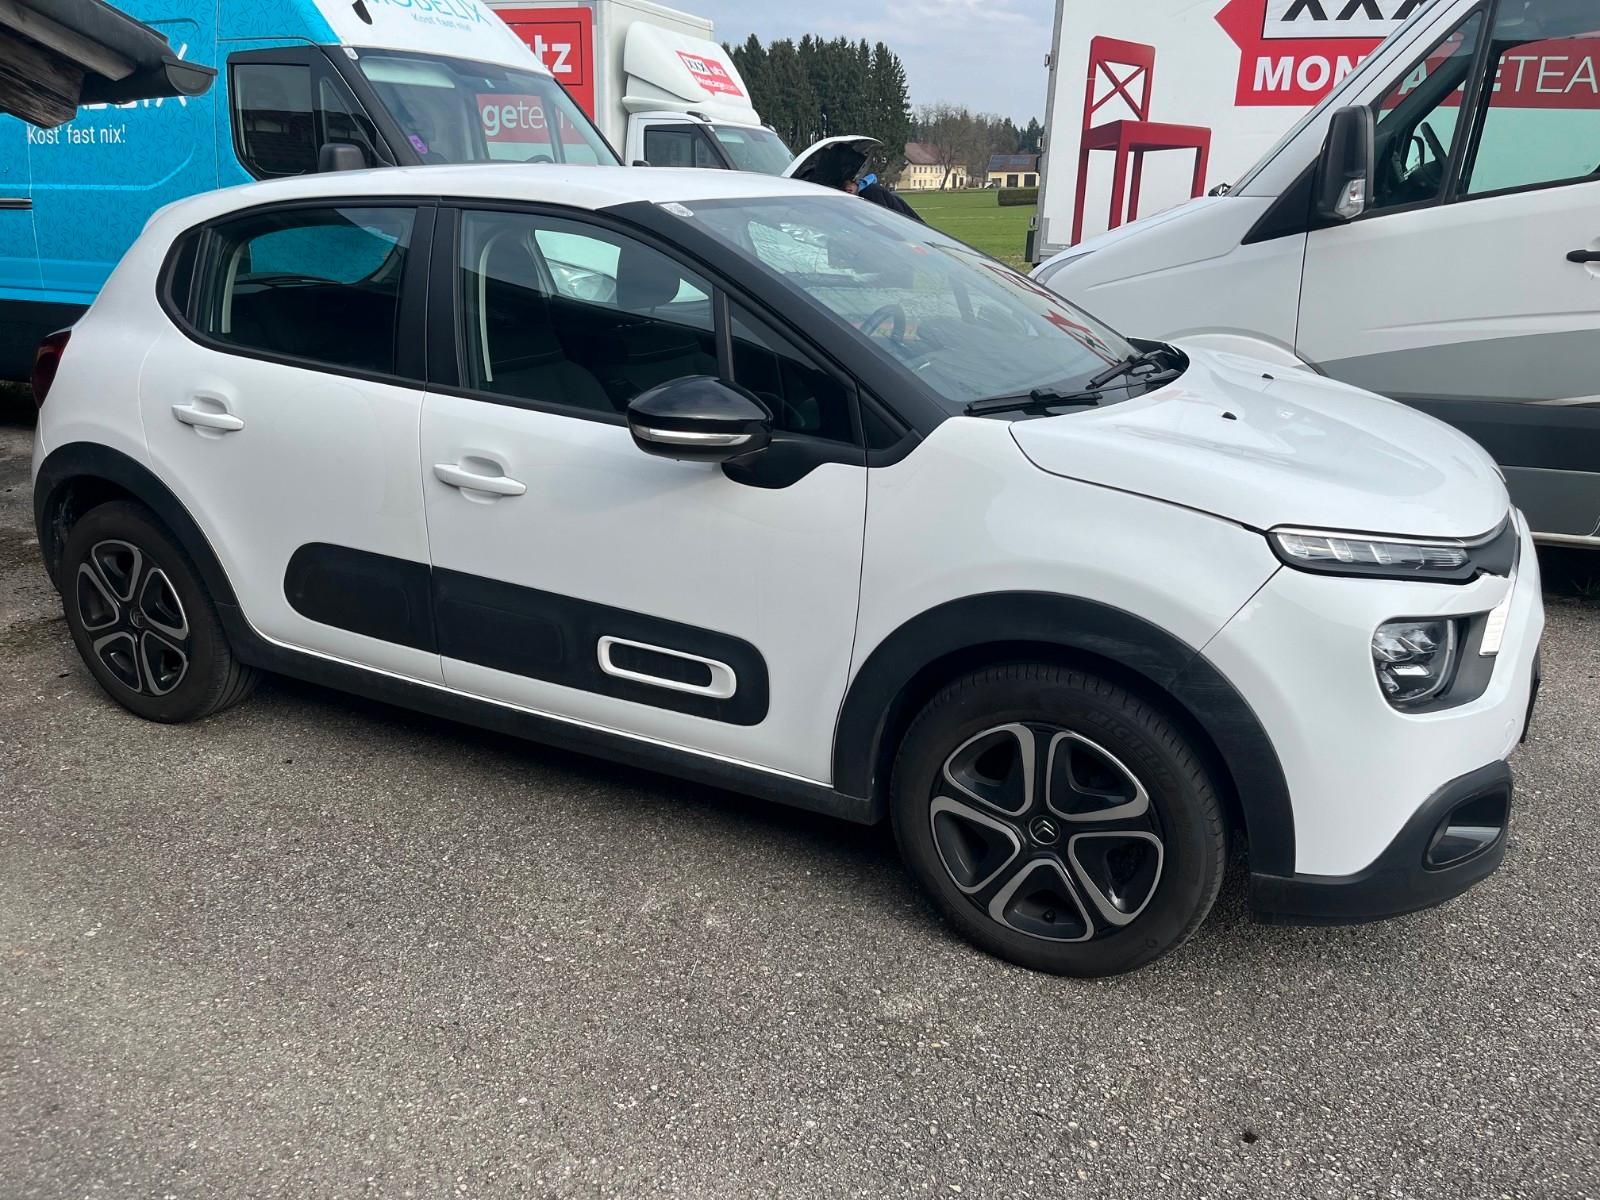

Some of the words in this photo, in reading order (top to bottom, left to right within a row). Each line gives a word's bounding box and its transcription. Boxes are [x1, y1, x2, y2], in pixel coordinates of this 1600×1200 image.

[526, 35, 572, 73] tz
[67, 124, 95, 144] fast
[100, 123, 126, 144] nix!
